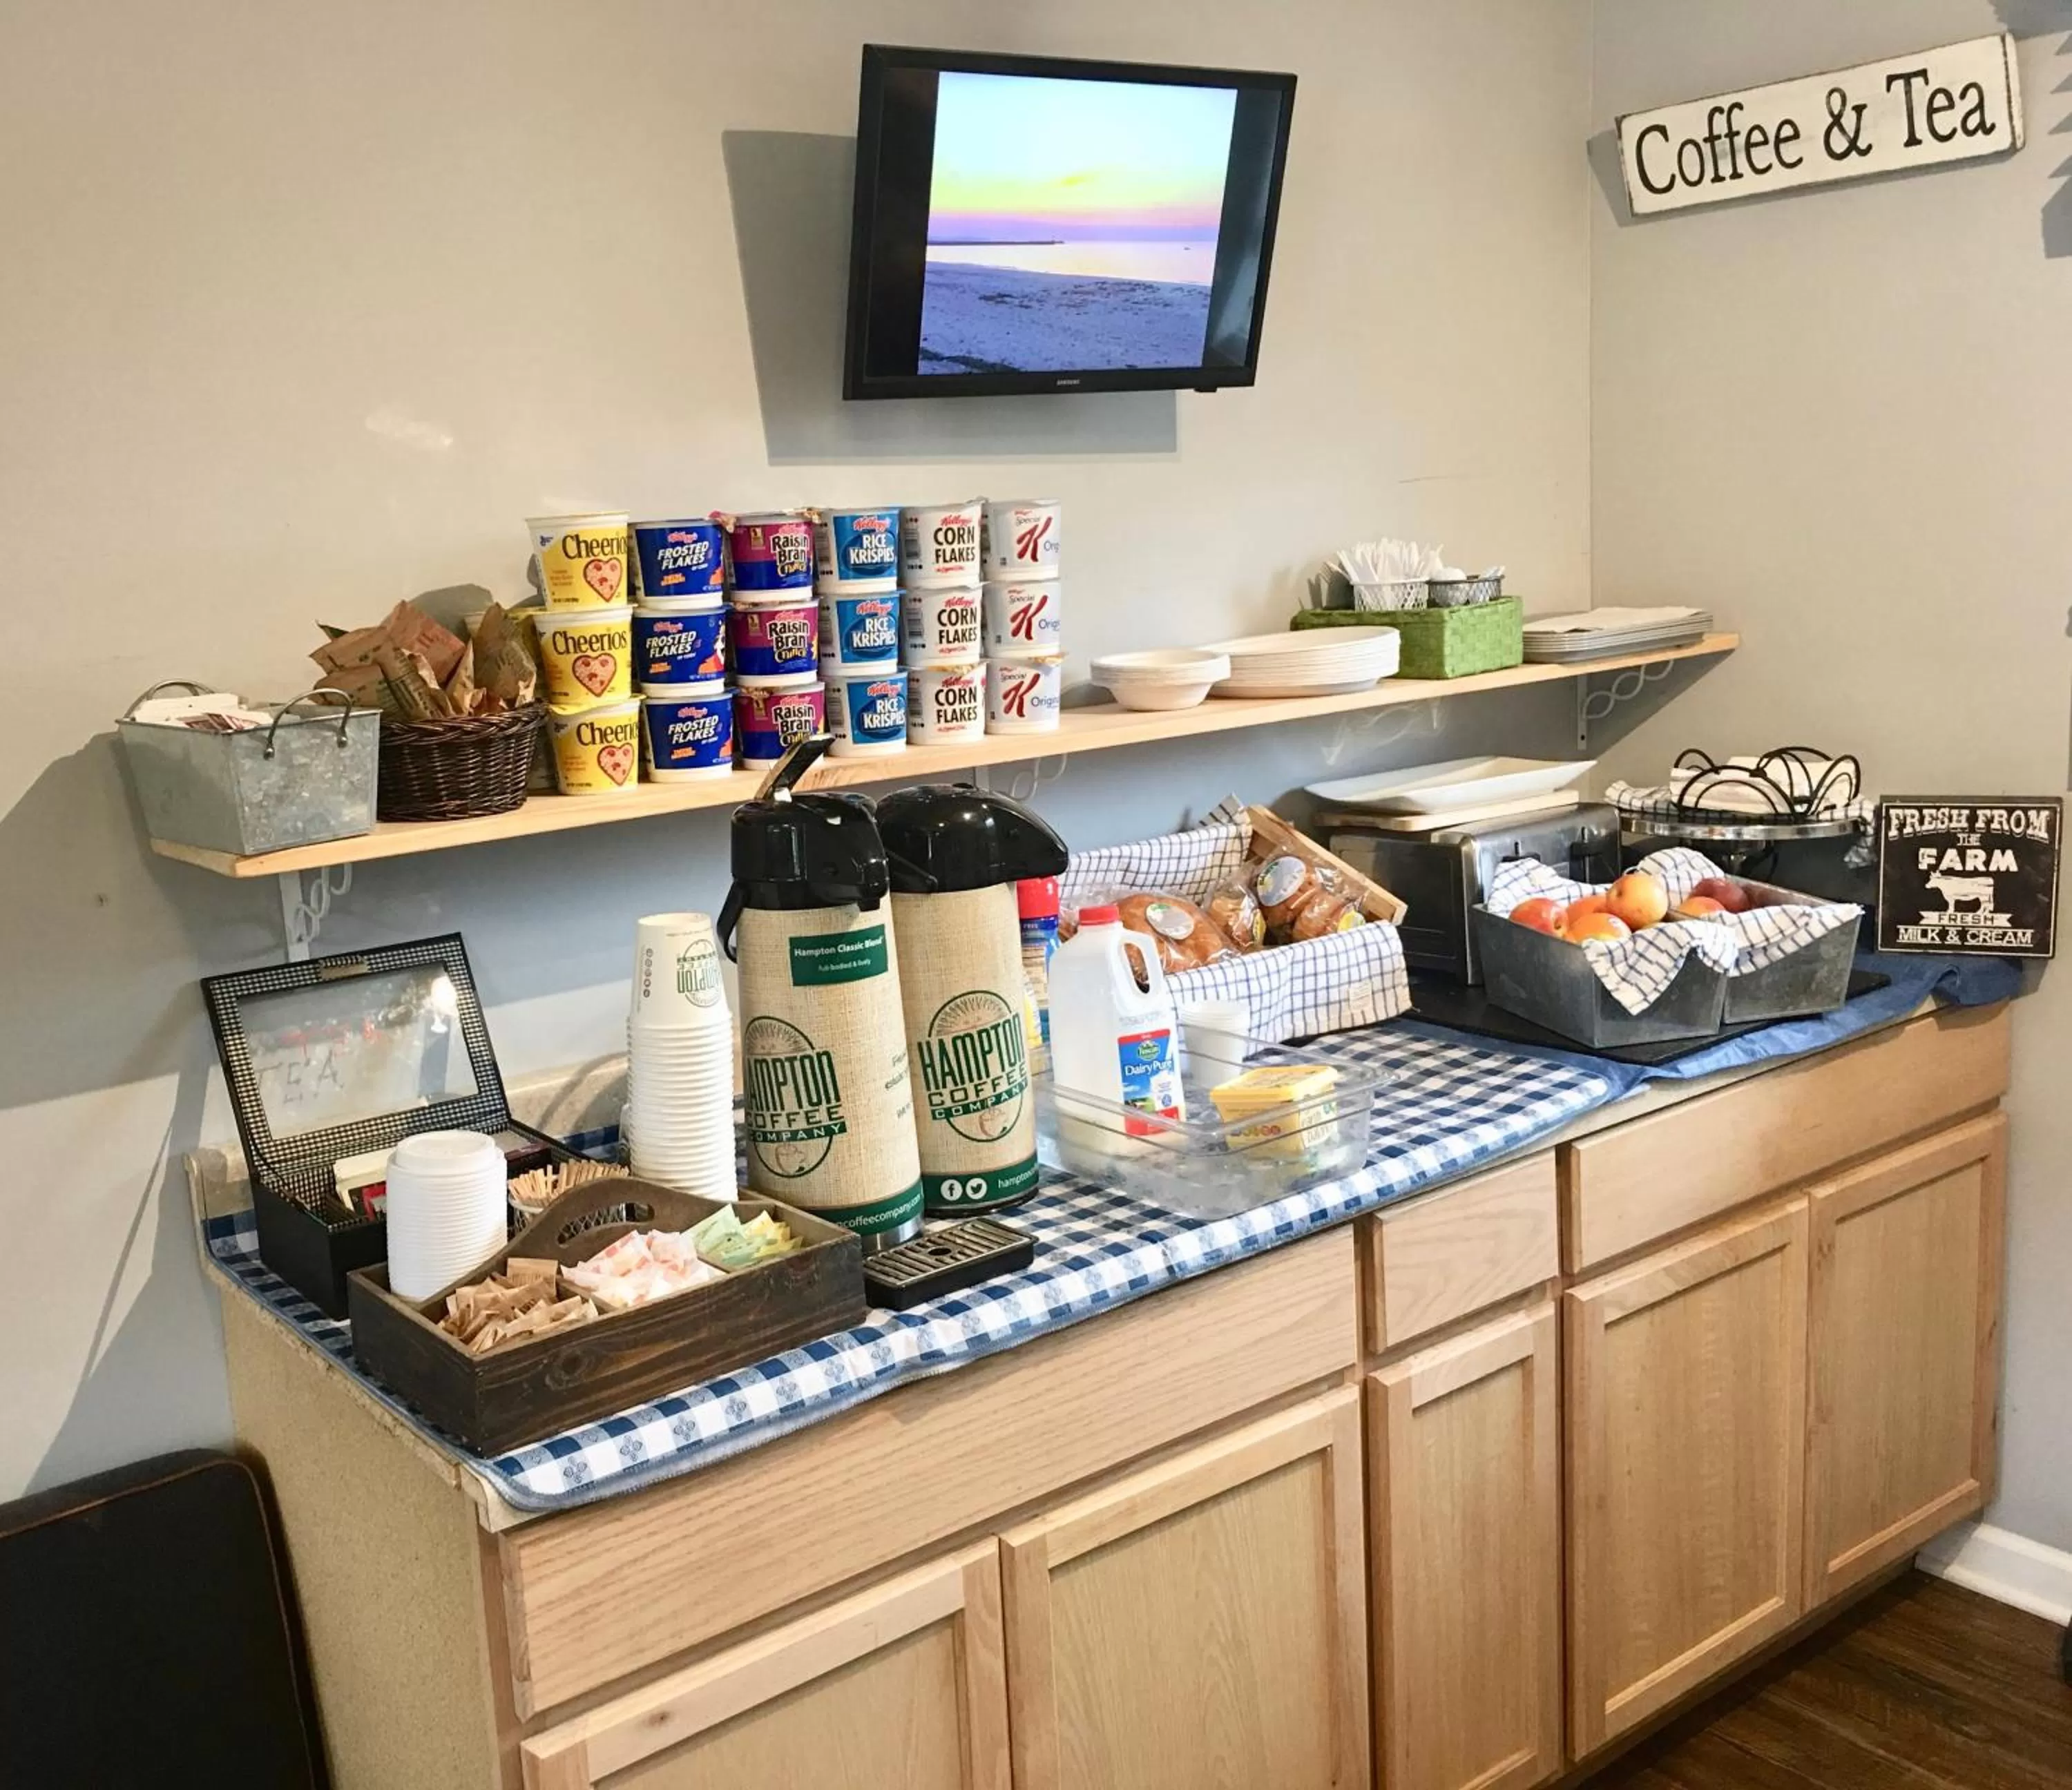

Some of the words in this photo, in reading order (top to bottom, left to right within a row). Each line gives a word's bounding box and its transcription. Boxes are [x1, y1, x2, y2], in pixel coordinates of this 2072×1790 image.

[1635, 102, 1803, 194] Coffee
[1823, 87, 1872, 161] &
[1886, 68, 1996, 147] Tea
[771, 535, 807, 552] Raisin
[863, 534, 886, 549] RICE
[934, 526, 975, 546] CORN
[1016, 516, 1053, 562] K
[562, 532, 627, 560] Cheerio
[658, 541, 709, 560] FROSTED
[935, 546, 975, 564] FLAKES
[662, 552, 705, 570] FLAKES
[778, 549, 806, 564] Bran
[850, 547, 894, 564] KRISPIES
[865, 617, 889, 632] RICE
[937, 606, 977, 627] CORN
[1010, 595, 1048, 641] K
[768, 622, 809, 637] Raisin
[852, 629, 895, 648] KRISPIES
[939, 626, 977, 644] FLAKES
[553, 627, 626, 655] Cheerios
[646, 631, 696, 648] FROSTED
[774, 635, 806, 651] Bran
[650, 642, 692, 658] FLAKES
[934, 686, 977, 706] CORN
[1002, 673, 1040, 718] K
[773, 705, 814, 722] Raisin
[876, 698, 899, 713] RICE
[863, 709, 905, 729] KRISPIES
[937, 706, 977, 724] FLAKES
[668, 715, 719, 735] FROSTED
[780, 718, 811, 734] Bran
[672, 726, 716, 744] FLAKES
[1888, 807, 1970, 840] FRESH
[1975, 809, 2049, 843] FROM
[1957, 834, 1981, 846] THE
[1918, 847, 2018, 872] FARM
[1938, 914, 1995, 924] FRESH
[1899, 927, 1941, 943] MILK
[1946, 930, 1960, 943] &
[1966, 930, 2032, 945] CREAM
[794, 947, 836, 957] Hampton
[837, 941, 863, 952] Classic
[917, 1012, 1025, 1091] HAMPTON
[746, 1050, 841, 1113] AMPTON
[928, 1061, 1027, 1106] COFFEE
[935, 1081, 1028, 1118] COMPANY
[750, 1123, 841, 1141] OMPANY
